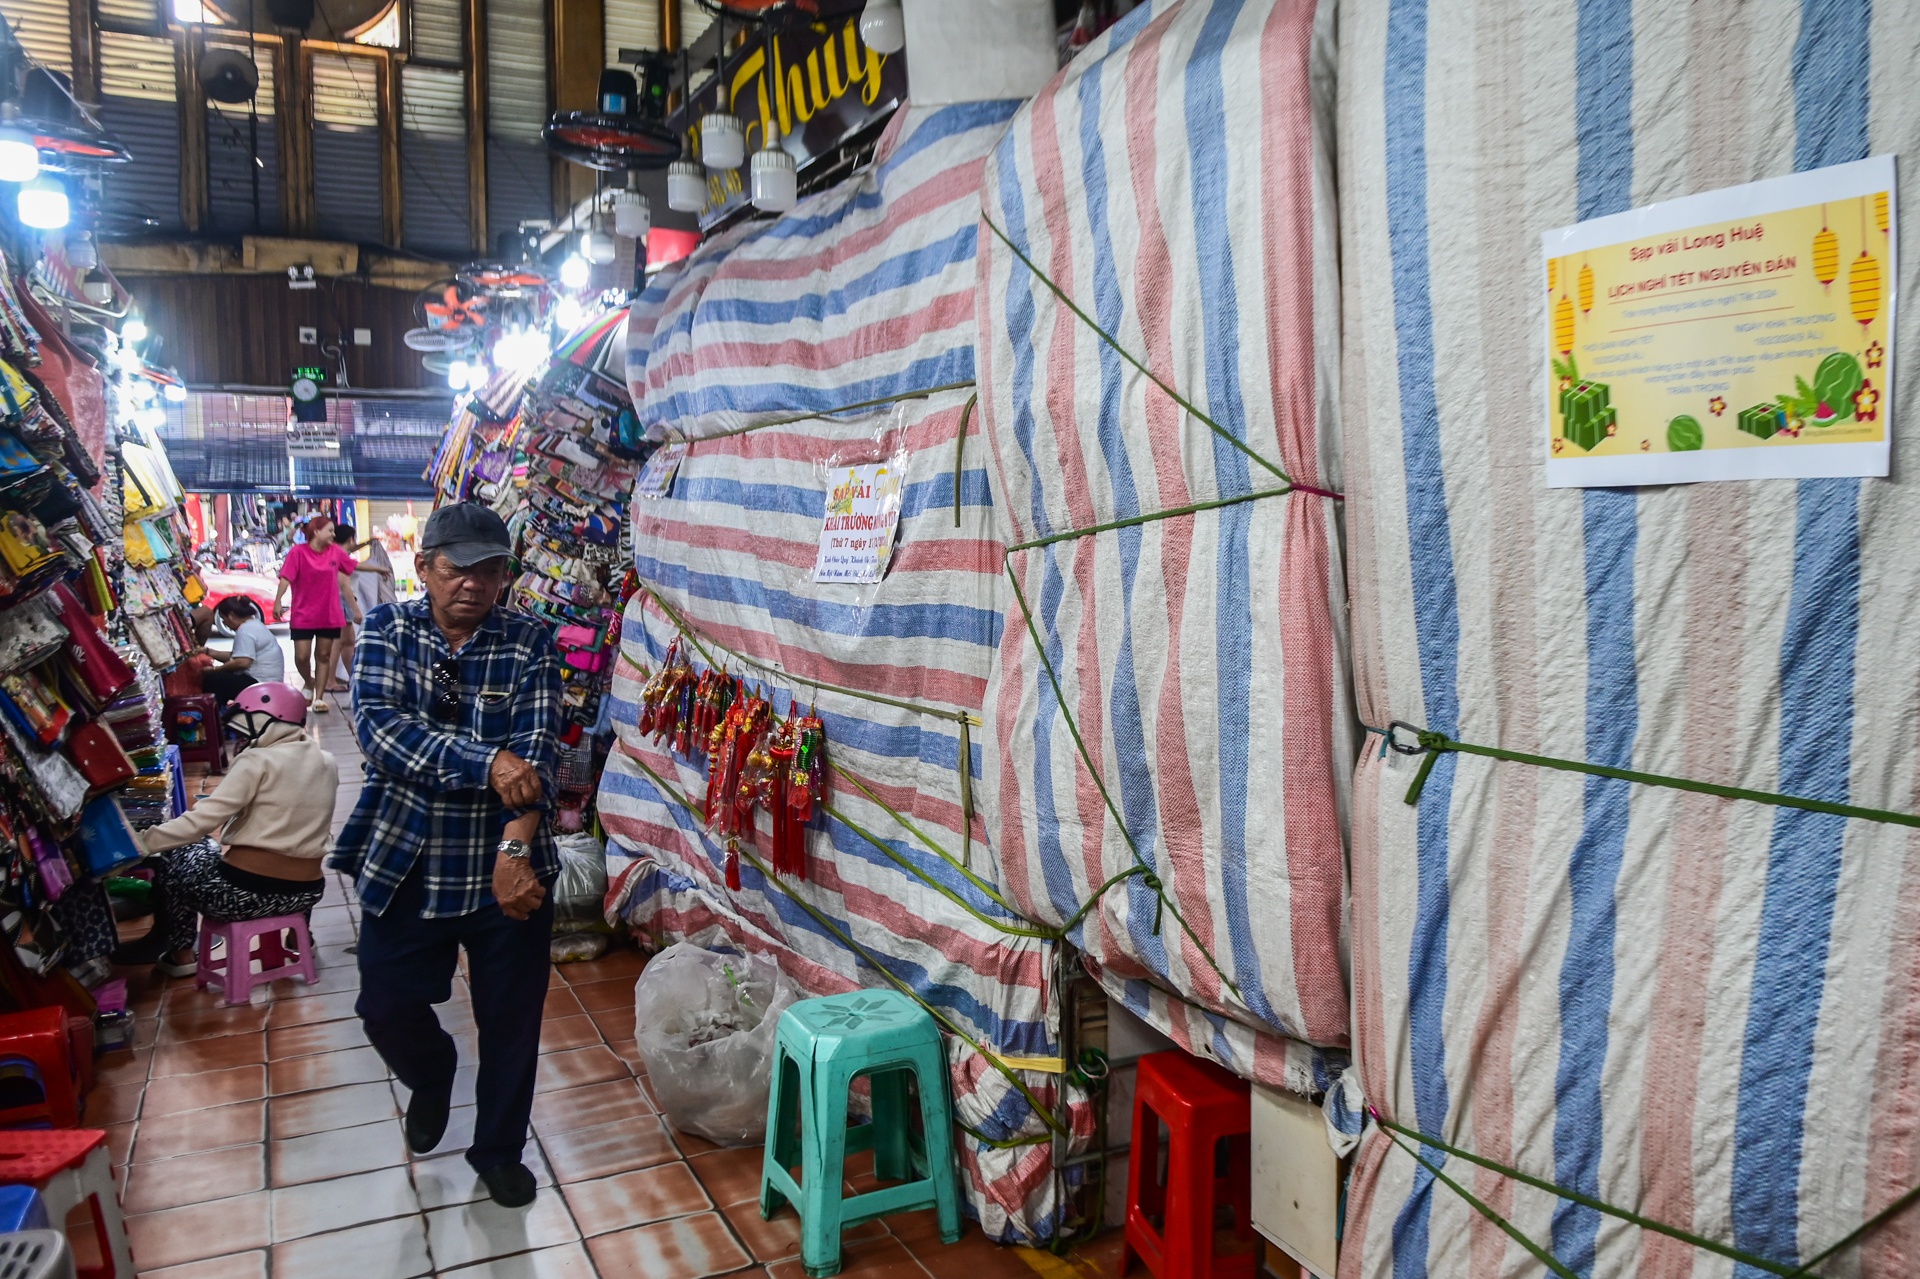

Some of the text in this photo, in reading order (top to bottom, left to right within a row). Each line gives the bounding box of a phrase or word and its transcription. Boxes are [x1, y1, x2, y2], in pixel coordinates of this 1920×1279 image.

[1629, 222, 1765, 262] Sạp vải Long Huệ
[1607, 284, 1635, 300] LỊCH
[1670, 270, 1696, 287] TẾT
[1699, 260, 1762, 283] NGUYÊN
[1765, 255, 1797, 274] ĐÁN
[851, 479, 871, 499] VẢI
[824, 516, 841, 532] KHAI
[840, 512, 874, 531] TRƯƠNG
[844, 538, 849, 548] 7
[850, 537, 867, 551] ngày
